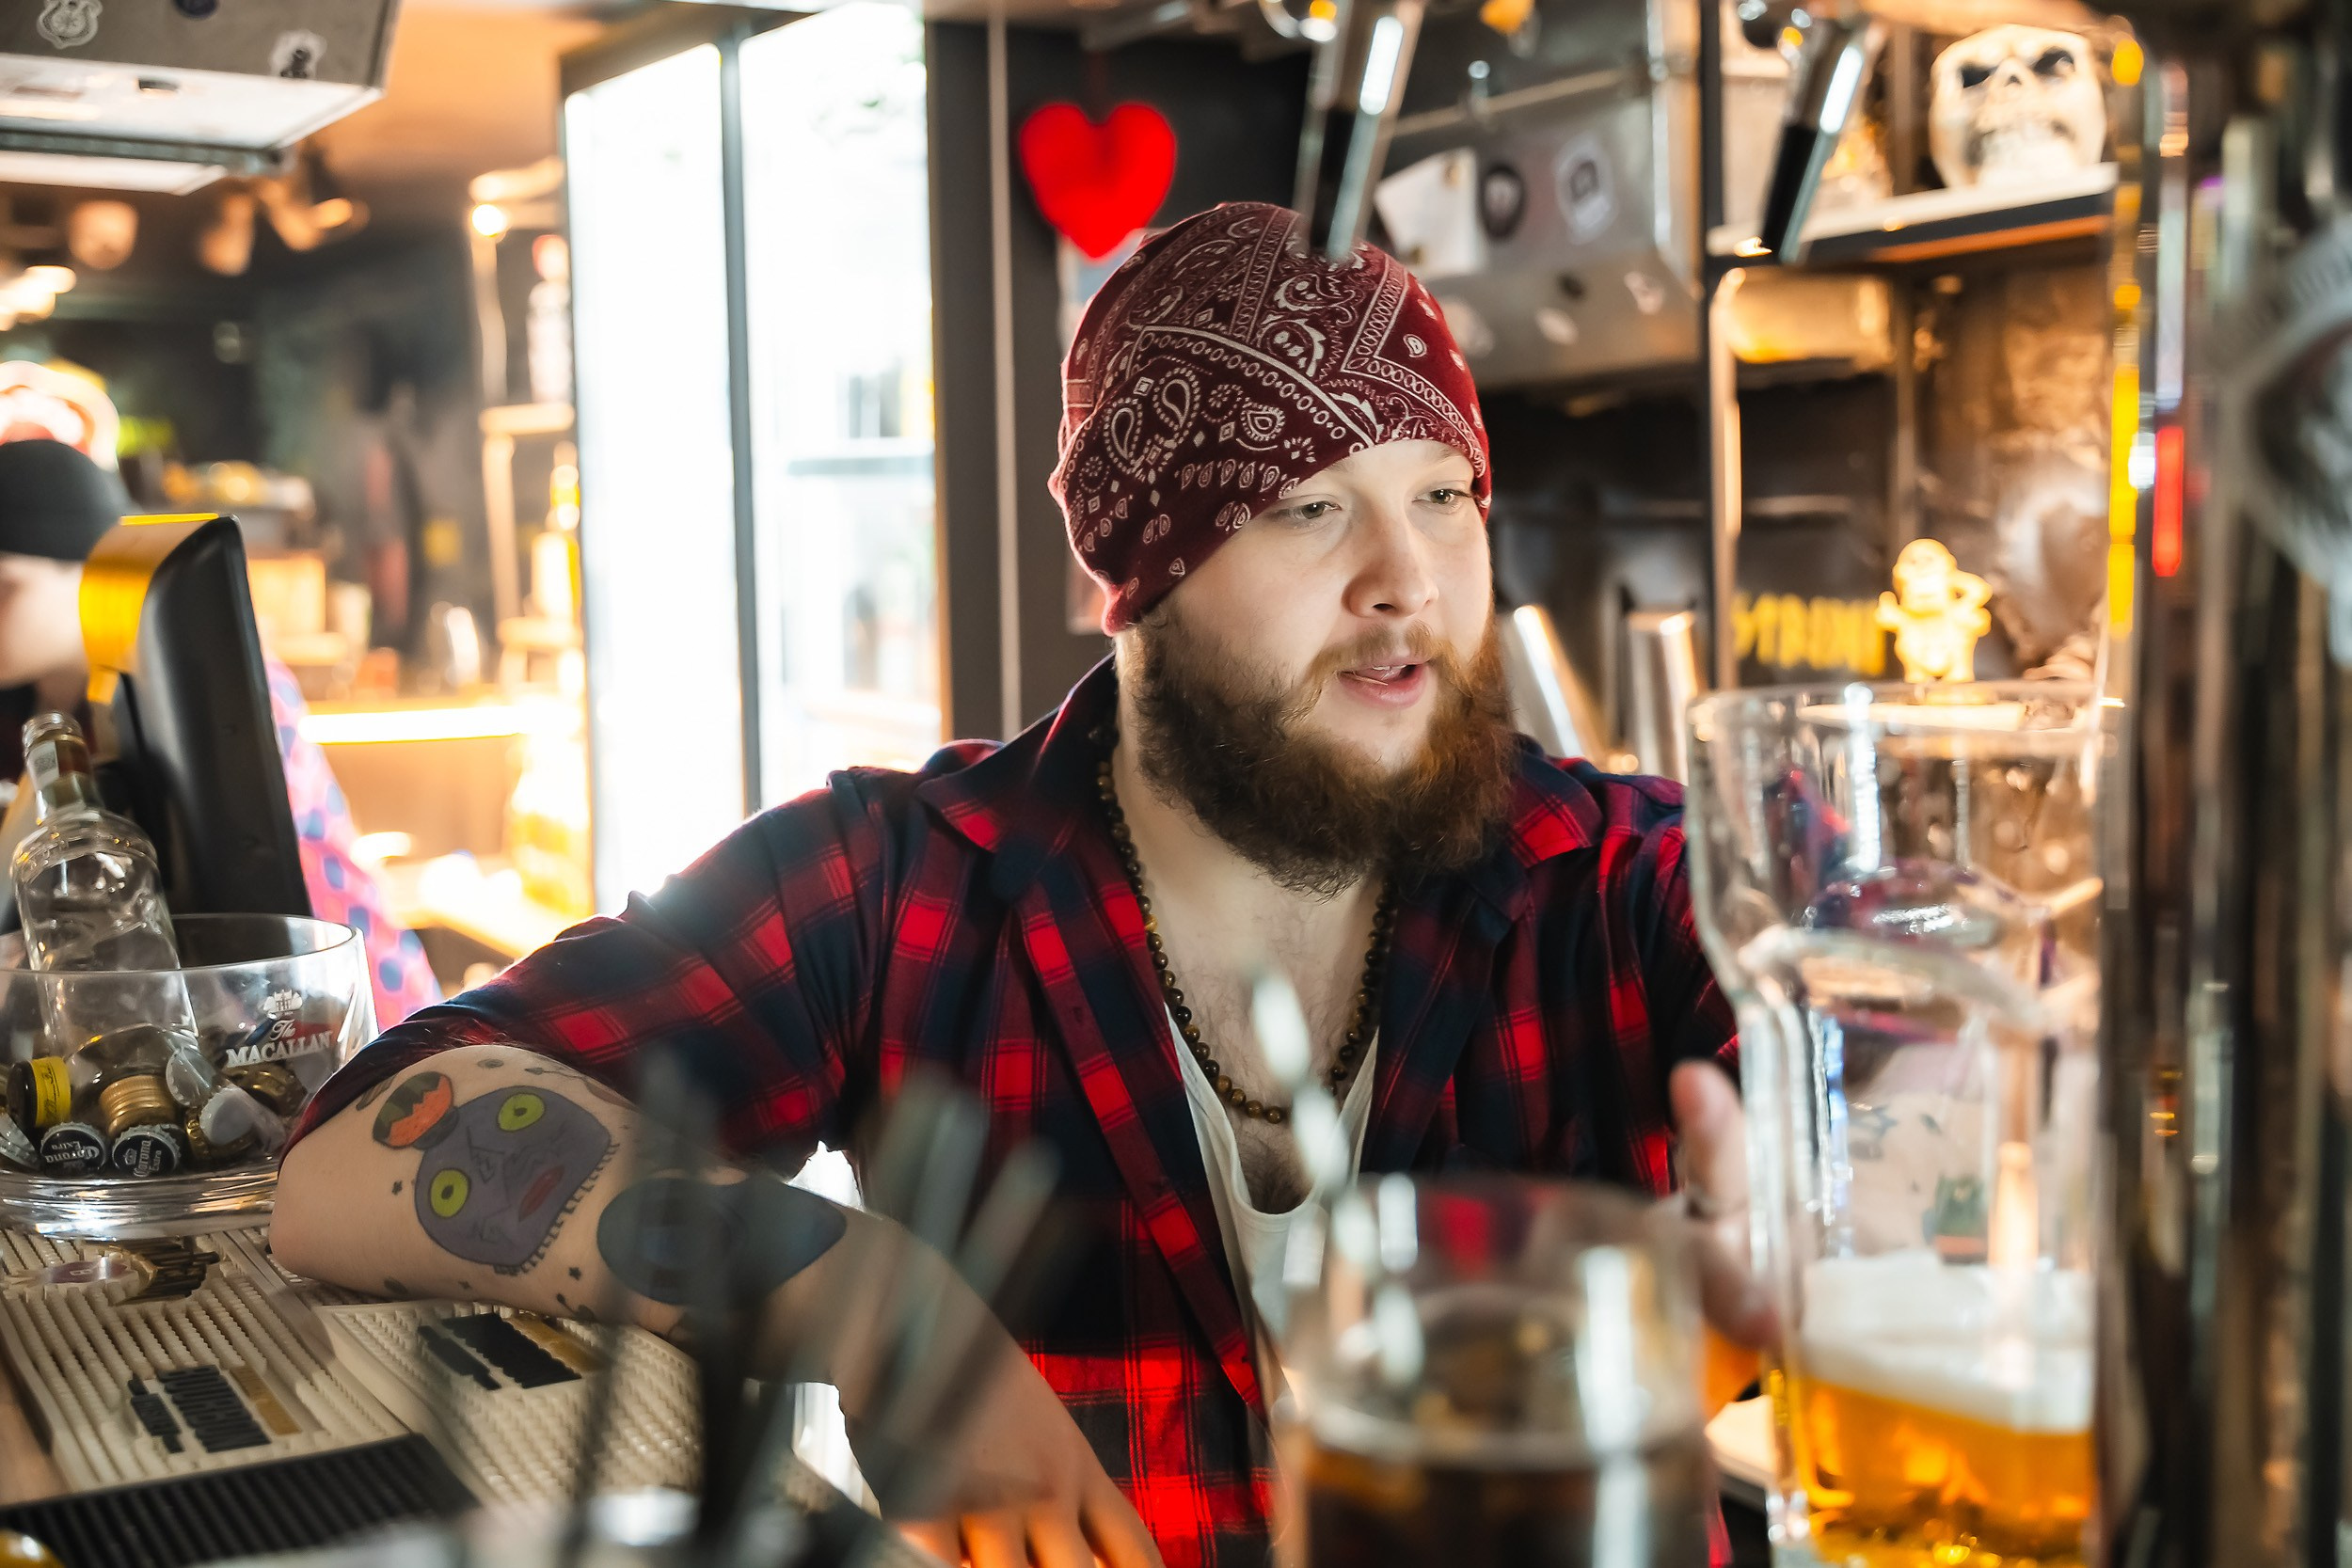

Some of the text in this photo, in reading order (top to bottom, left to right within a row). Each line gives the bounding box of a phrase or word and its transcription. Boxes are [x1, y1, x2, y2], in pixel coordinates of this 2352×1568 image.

[271, 1019, 295, 1040] The
[226, 1031, 332, 1068] MACALLAN
[45, 1146, 100, 1163] Corona
[52, 1141, 81, 1151] Extra
[134, 1140, 151, 1177] Corona
[150, 1150, 162, 1172] Extra
